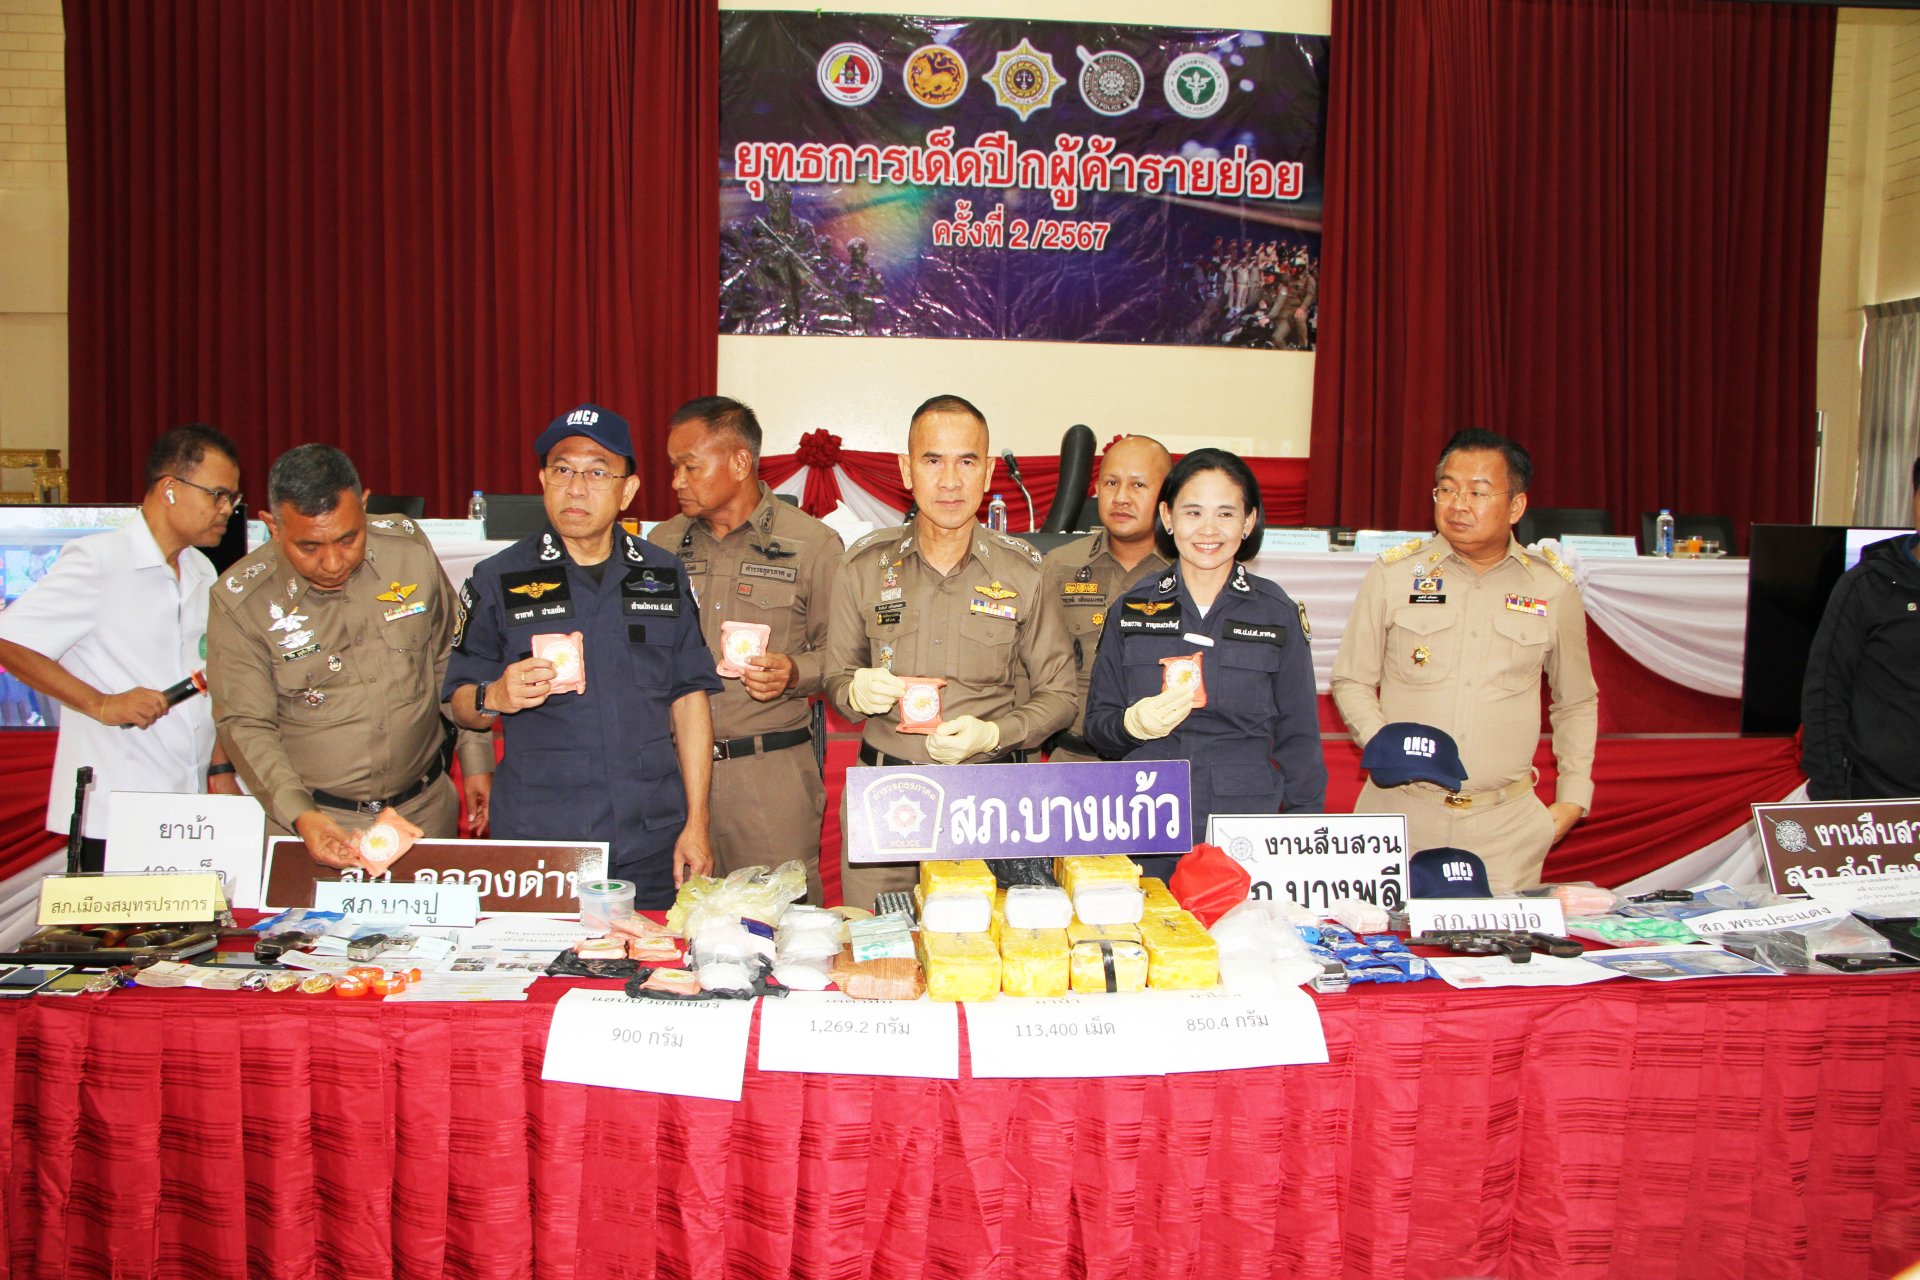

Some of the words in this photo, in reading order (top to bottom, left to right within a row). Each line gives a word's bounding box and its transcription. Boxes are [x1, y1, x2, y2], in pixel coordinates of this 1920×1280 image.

[735, 127, 1304, 208] ยุทธการเด็ดปีกผู้ค้ารายย่อย
[933, 199, 1004, 248] ครั้งที่
[1010, 217, 1111, 250] 2/2567
[566, 409, 599, 424] ONCB
[1403, 736, 1436, 754] ONCB
[950, 770, 1180, 846] สภ.บางแก้ว
[159, 815, 215, 840] ยาบ้า
[890, 839, 921, 848] POLICE
[1265, 827, 1402, 855] งานสืบสวน
[1442, 861, 1474, 878] ONCB
[51, 895, 208, 918] สภ.เมืองสมุทรปราการ
[341, 892, 439, 924] สภ.บางปู
[1432, 903, 1542, 931] สภ.บางบ่อ
[1698, 906, 1832, 933] สภ.พระประแดง
[810, 1018, 869, 1036] 1,269.2
[875, 1016, 911, 1036] กรัม
[1015, 1021, 1079, 1038] 113,400
[1084, 1015, 1116, 1036] เม็ด
[1186, 1016, 1229, 1032] 850.4
[1236, 1009, 1270, 1029] กรัม
[611, 1027, 643, 1045] 900
[648, 1025, 684, 1048] กรัม
